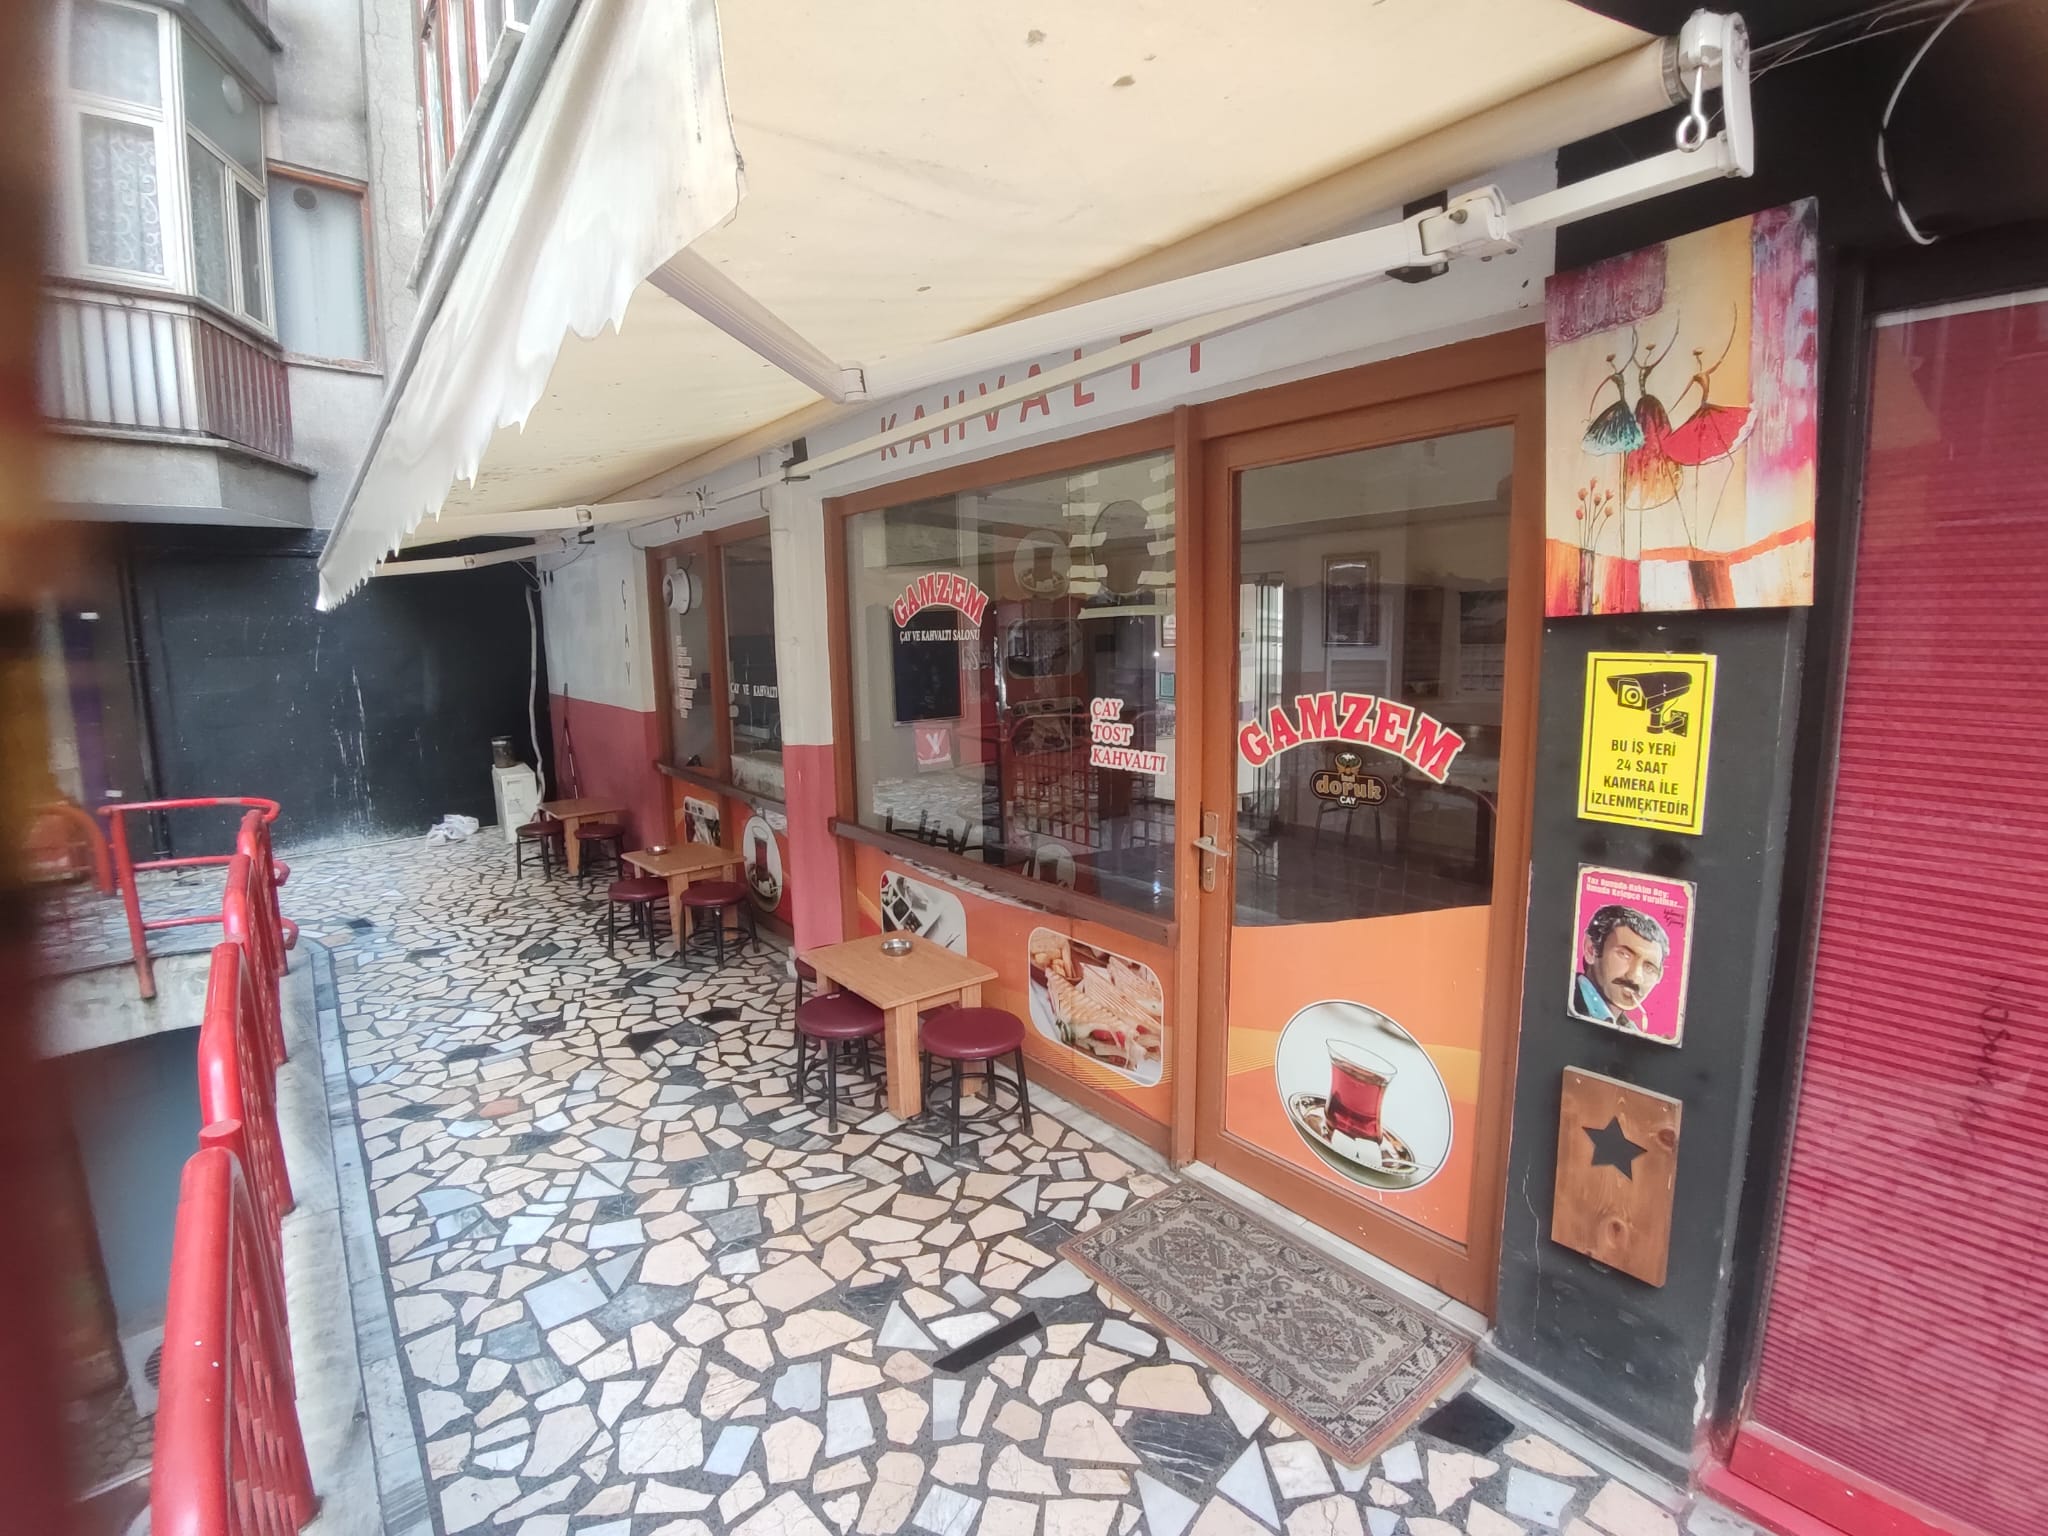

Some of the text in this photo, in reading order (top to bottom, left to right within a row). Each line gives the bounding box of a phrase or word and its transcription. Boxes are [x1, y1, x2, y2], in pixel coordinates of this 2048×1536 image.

[893, 571, 989, 628] GAMZEM
[900, 628, 980, 645] ÇAY VE KAHVALTI SALONU
[1091, 699, 1122, 721] ÇAY
[1092, 723, 1132, 744] TOST
[1239, 692, 1464, 783] GAMZEM
[1611, 738, 1676, 756] BU İŞ YERİ
[1092, 746, 1167, 773] KAHVALTI
[1616, 758, 1668, 775] 24 SAAT
[1315, 775, 1381, 800] doruk
[1603, 775, 1679, 795] KAMERA İLE
[1591, 790, 1689, 816] İZLENMEKTEDİR
